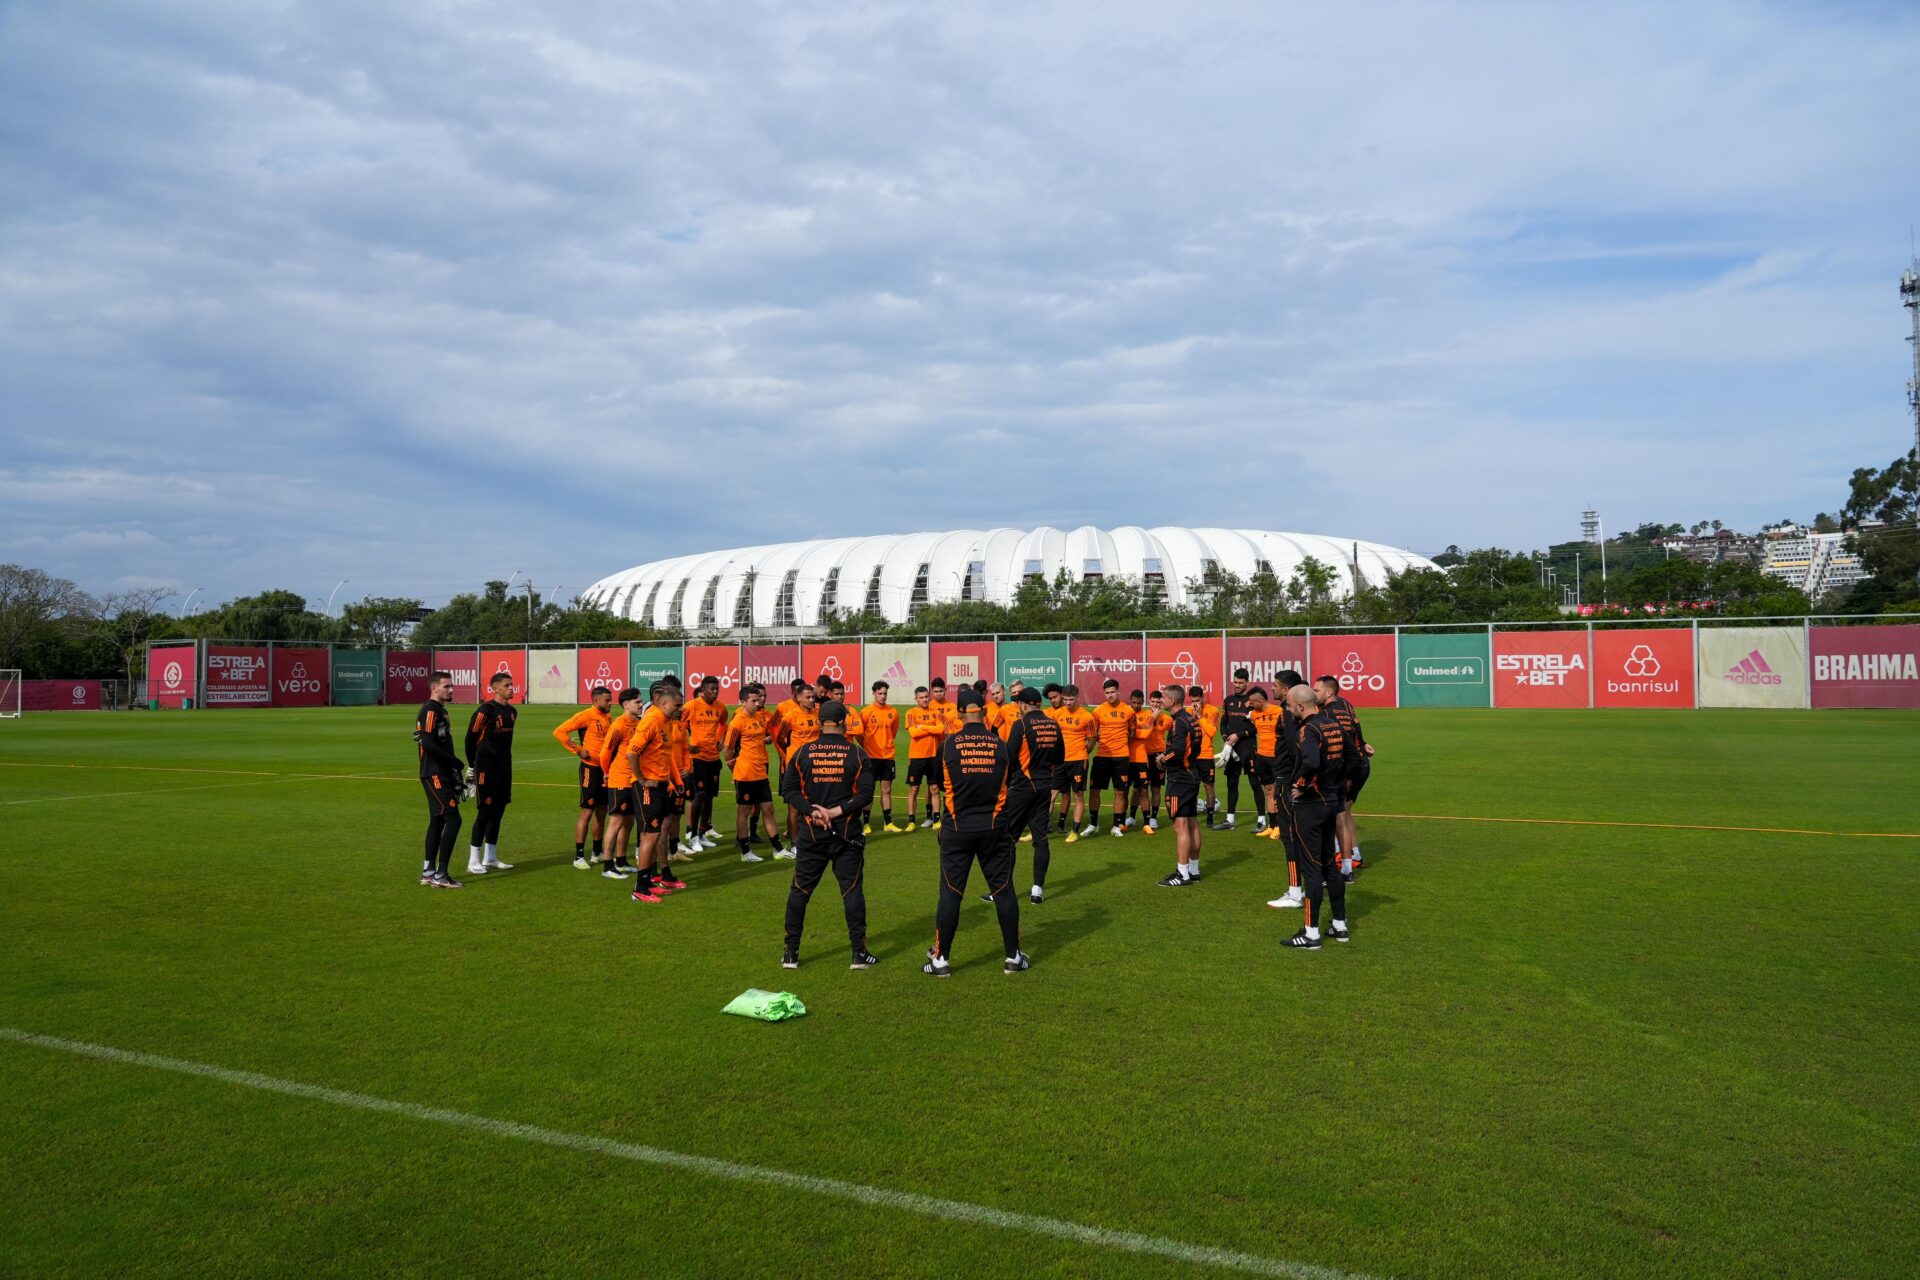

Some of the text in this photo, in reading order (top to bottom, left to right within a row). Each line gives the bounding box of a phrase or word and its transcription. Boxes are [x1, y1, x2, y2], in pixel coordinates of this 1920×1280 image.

[208, 655, 266, 669] ESTRELA
[1496, 654, 1585, 670] ESTRELA
[1814, 653, 1919, 681] BRAHMA
[230, 668, 256, 681] BET
[639, 669, 666, 677] Unimed
[745, 665, 798, 685] BRAHMA
[953, 663, 974, 678] JBL
[1009, 665, 1044, 675] Unimed
[1413, 665, 1458, 676] Unimed
[436, 669, 477, 686] AHMA
[584, 678, 623, 691] vero
[1326, 674, 1386, 691] ero
[1529, 670, 1569, 686] BET
[278, 679, 321, 693] vero
[1607, 679, 1680, 693] banrisul
[964, 734, 999, 742] banrisul
[961, 749, 995, 757] Unimed
[812, 758, 845, 766] Unimed
